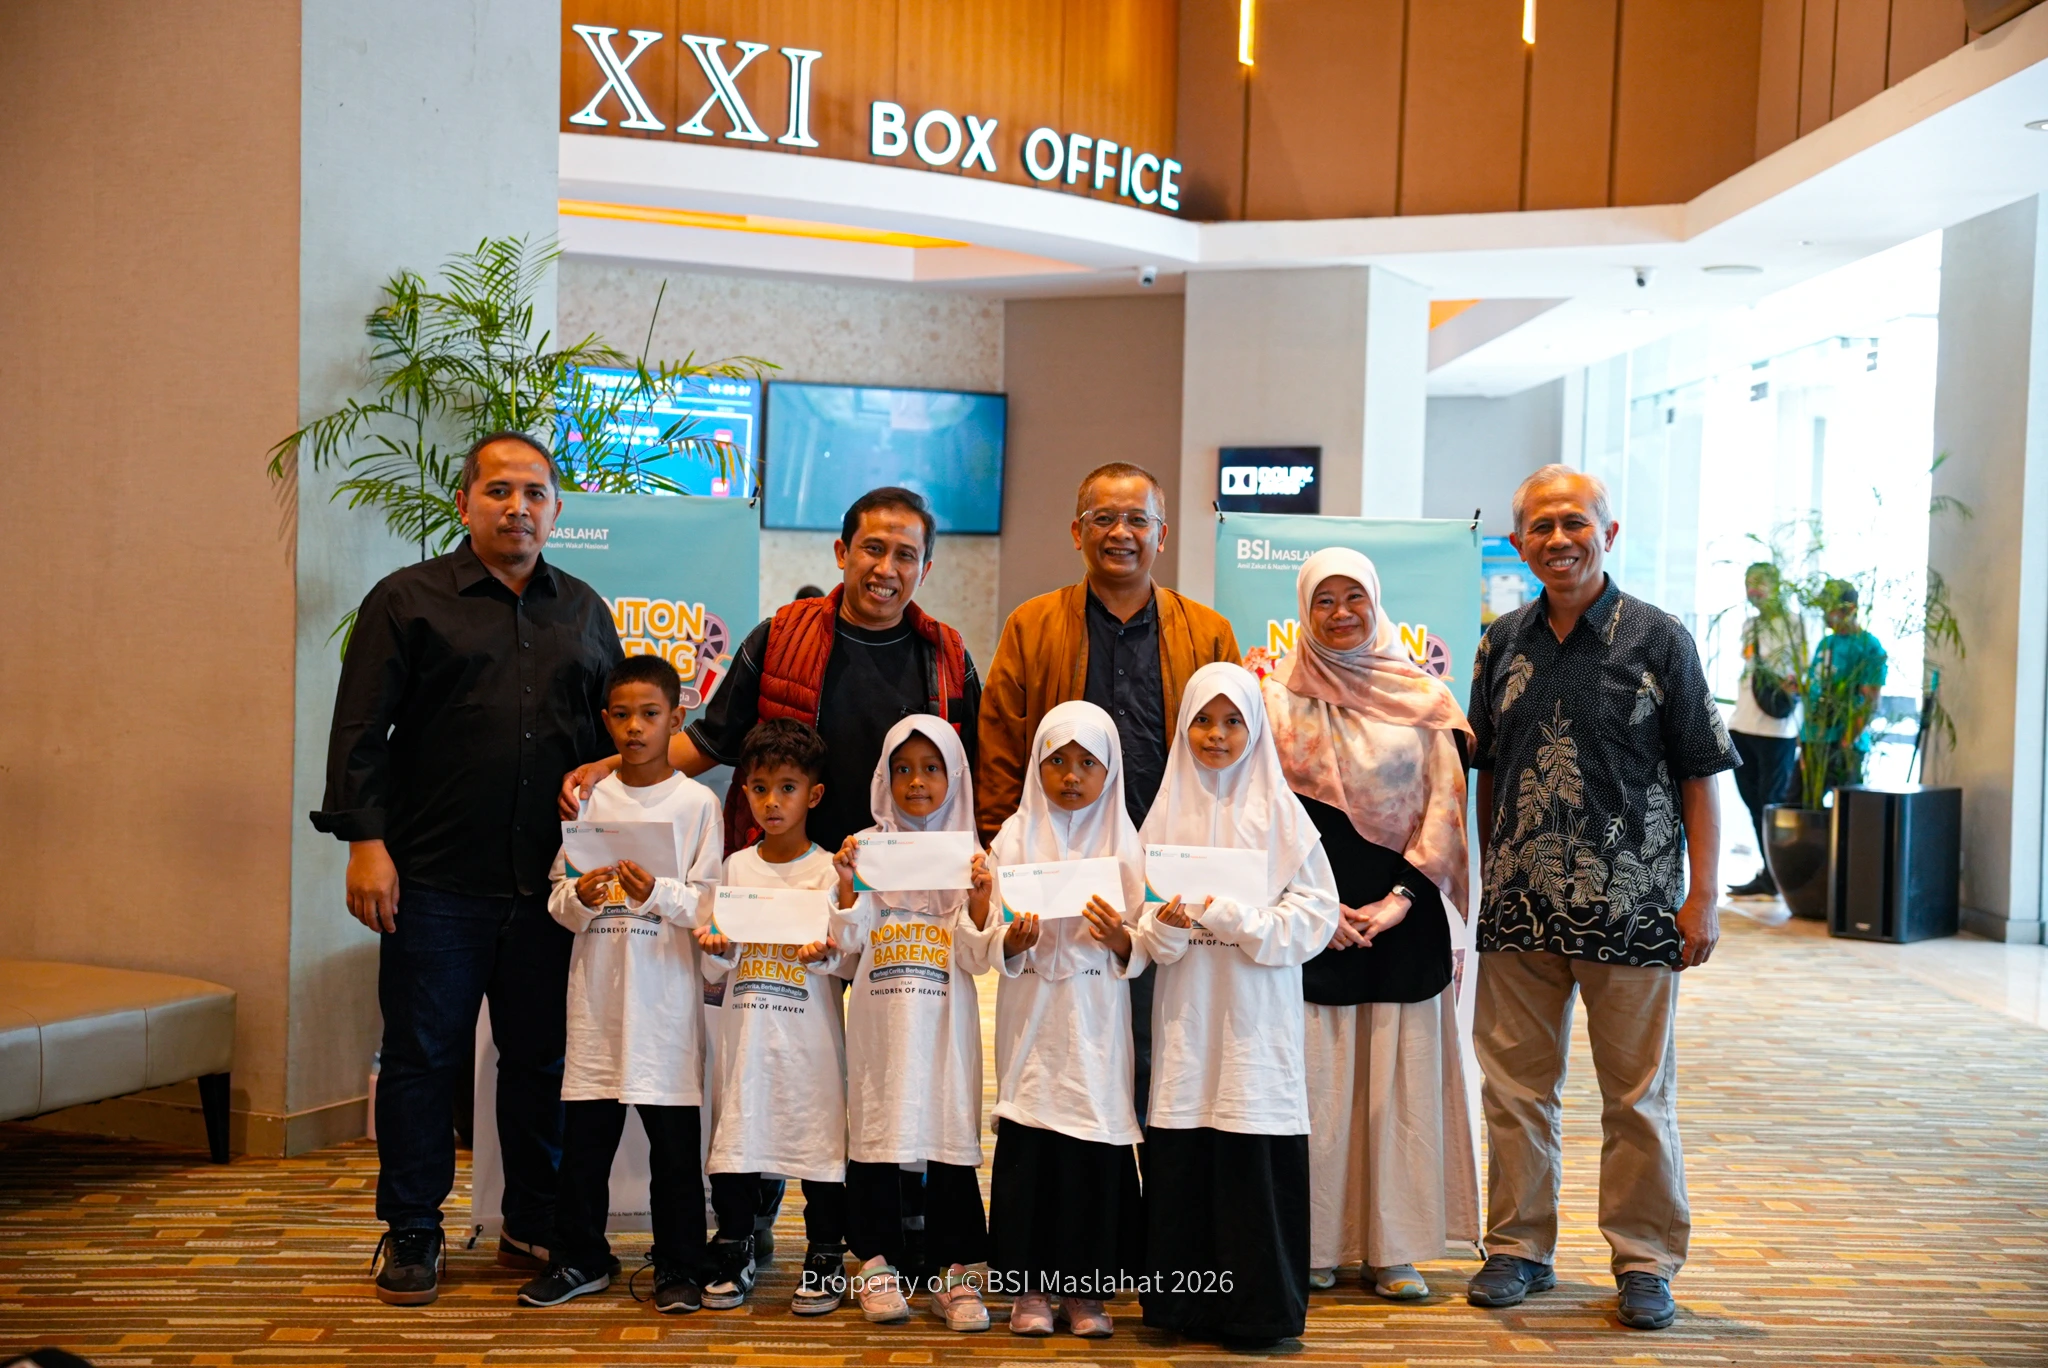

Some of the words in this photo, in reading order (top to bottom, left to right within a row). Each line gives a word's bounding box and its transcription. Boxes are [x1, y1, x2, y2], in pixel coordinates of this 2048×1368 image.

[569, 24, 822, 148] XXI
[871, 101, 997, 172] BOX
[1024, 127, 1181, 210] OFFICE
[1237, 539, 1270, 560] BSI
[1272, 549, 1316, 561] MASLA
[604, 597, 705, 642] NTON
[630, 927, 658, 937] HEAVEN
[870, 923, 952, 949] NONTON
[741, 943, 799, 961] ONTO
[873, 943, 949, 969] BARENG
[737, 959, 807, 986] ARENG
[870, 987, 902, 996] CHILDREN
[919, 988, 947, 997] HEAVEN
[772, 1004, 805, 1014] HEAVEN
